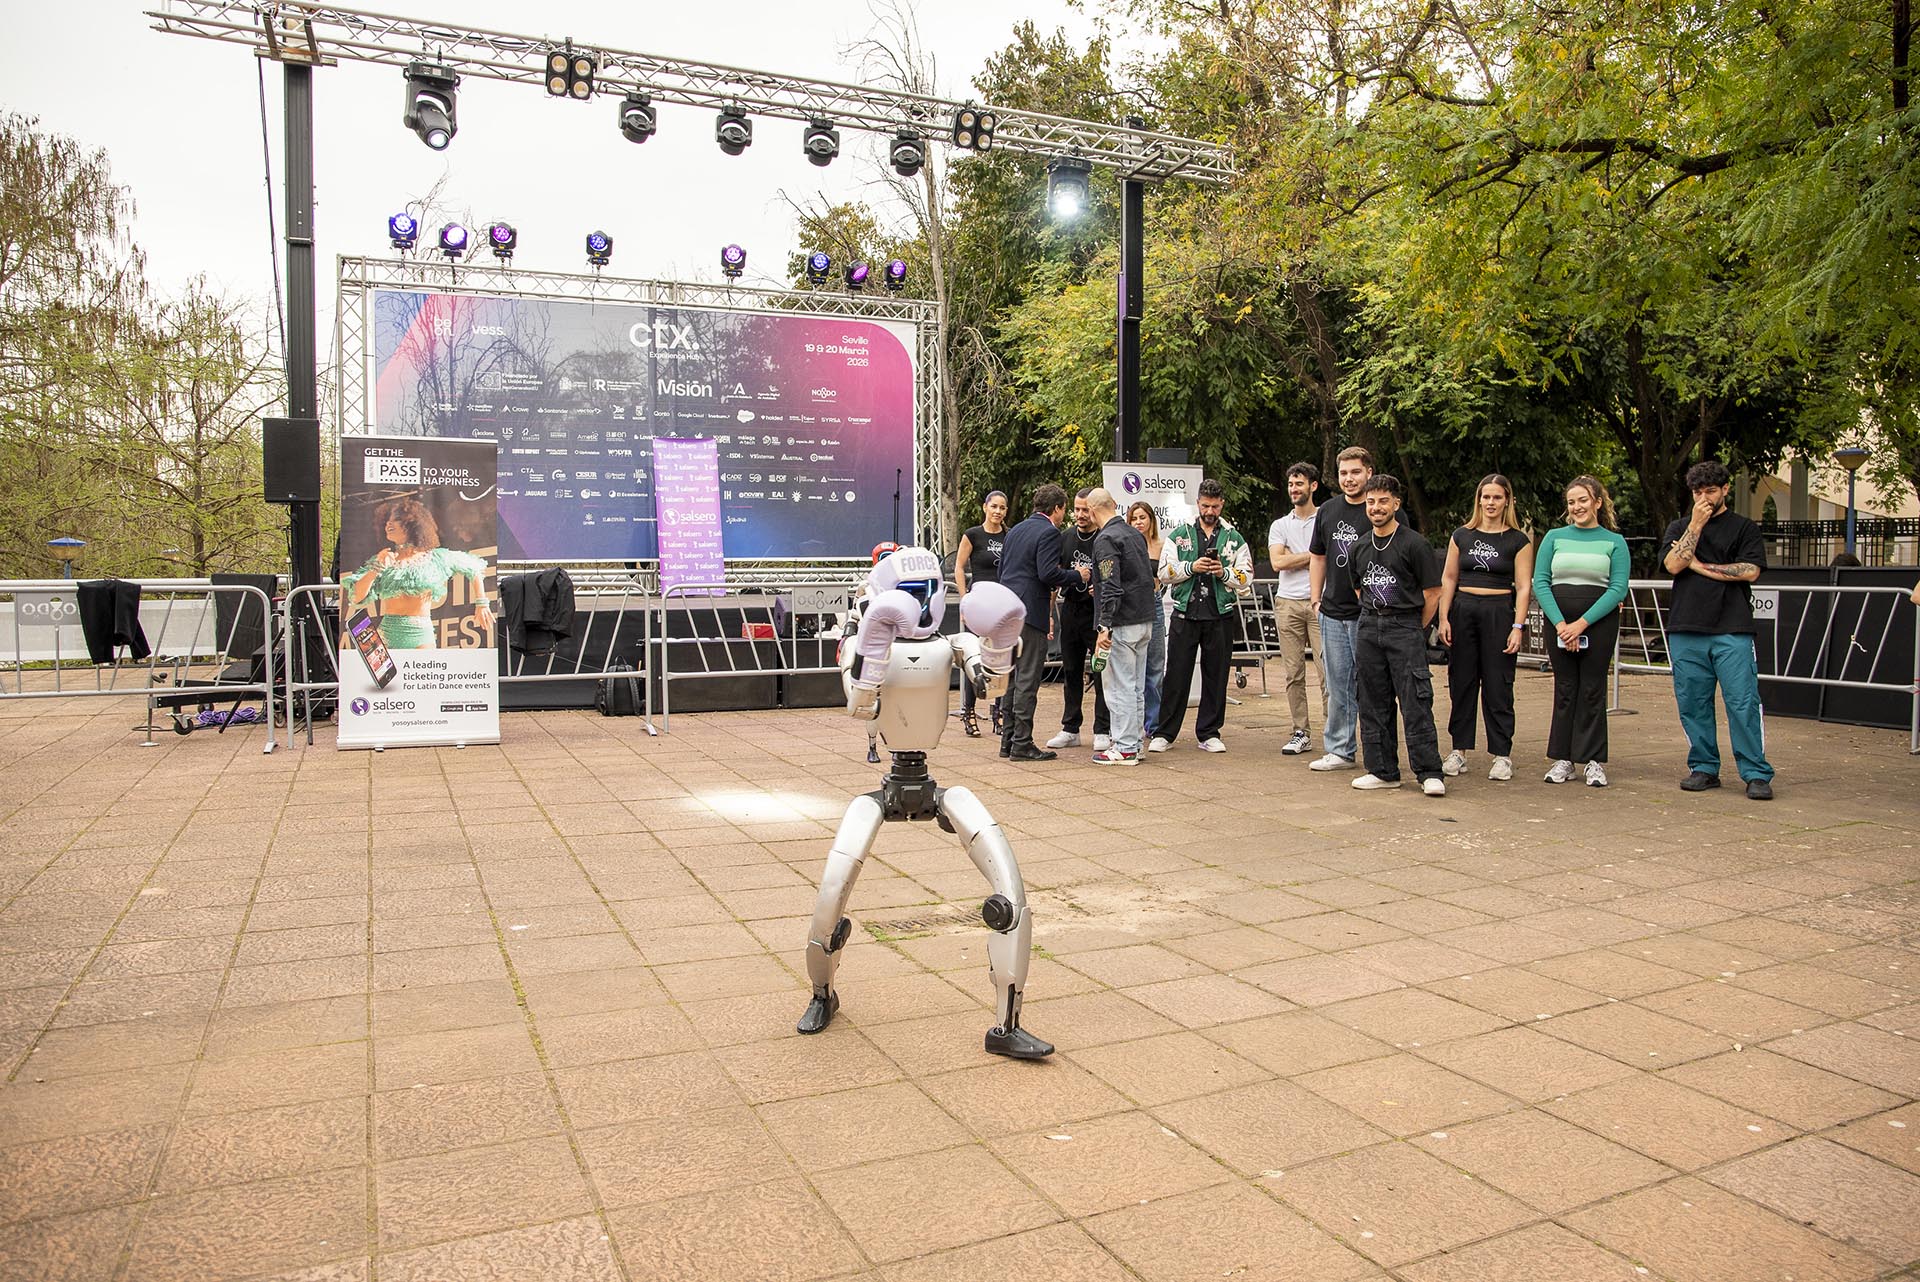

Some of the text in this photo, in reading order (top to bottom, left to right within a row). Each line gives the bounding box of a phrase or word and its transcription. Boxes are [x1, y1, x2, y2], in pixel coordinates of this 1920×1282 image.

[629, 319, 700, 350] ctx.
[842, 335, 869, 345] Seville
[805, 344, 815, 352] 19
[826, 345, 838, 353] 20
[839, 345, 869, 355] March
[650, 351, 686, 359] Experience
[847, 357, 869, 366] 2026
[365, 448, 404, 457] GET THE
[380, 465, 417, 477] PASS
[423, 468, 469, 478] TO YOUR
[423, 477, 480, 487] HAPPINESS
[1145, 473, 1186, 490] salsero
[681, 510, 717, 522] salsero
[1332, 530, 1359, 541] salsero
[1468, 548, 1499, 558] salsero
[901, 554, 937, 573] FORCE
[1363, 572, 1397, 586] salsero
[403, 660, 448, 671] A leading
[403, 672, 487, 682] ticketing provider
[438, 682, 463, 690] Dance
[464, 682, 491, 690] events
[373, 697, 416, 711] salsero
[391, 719, 449, 728] yosoysalsero.com
